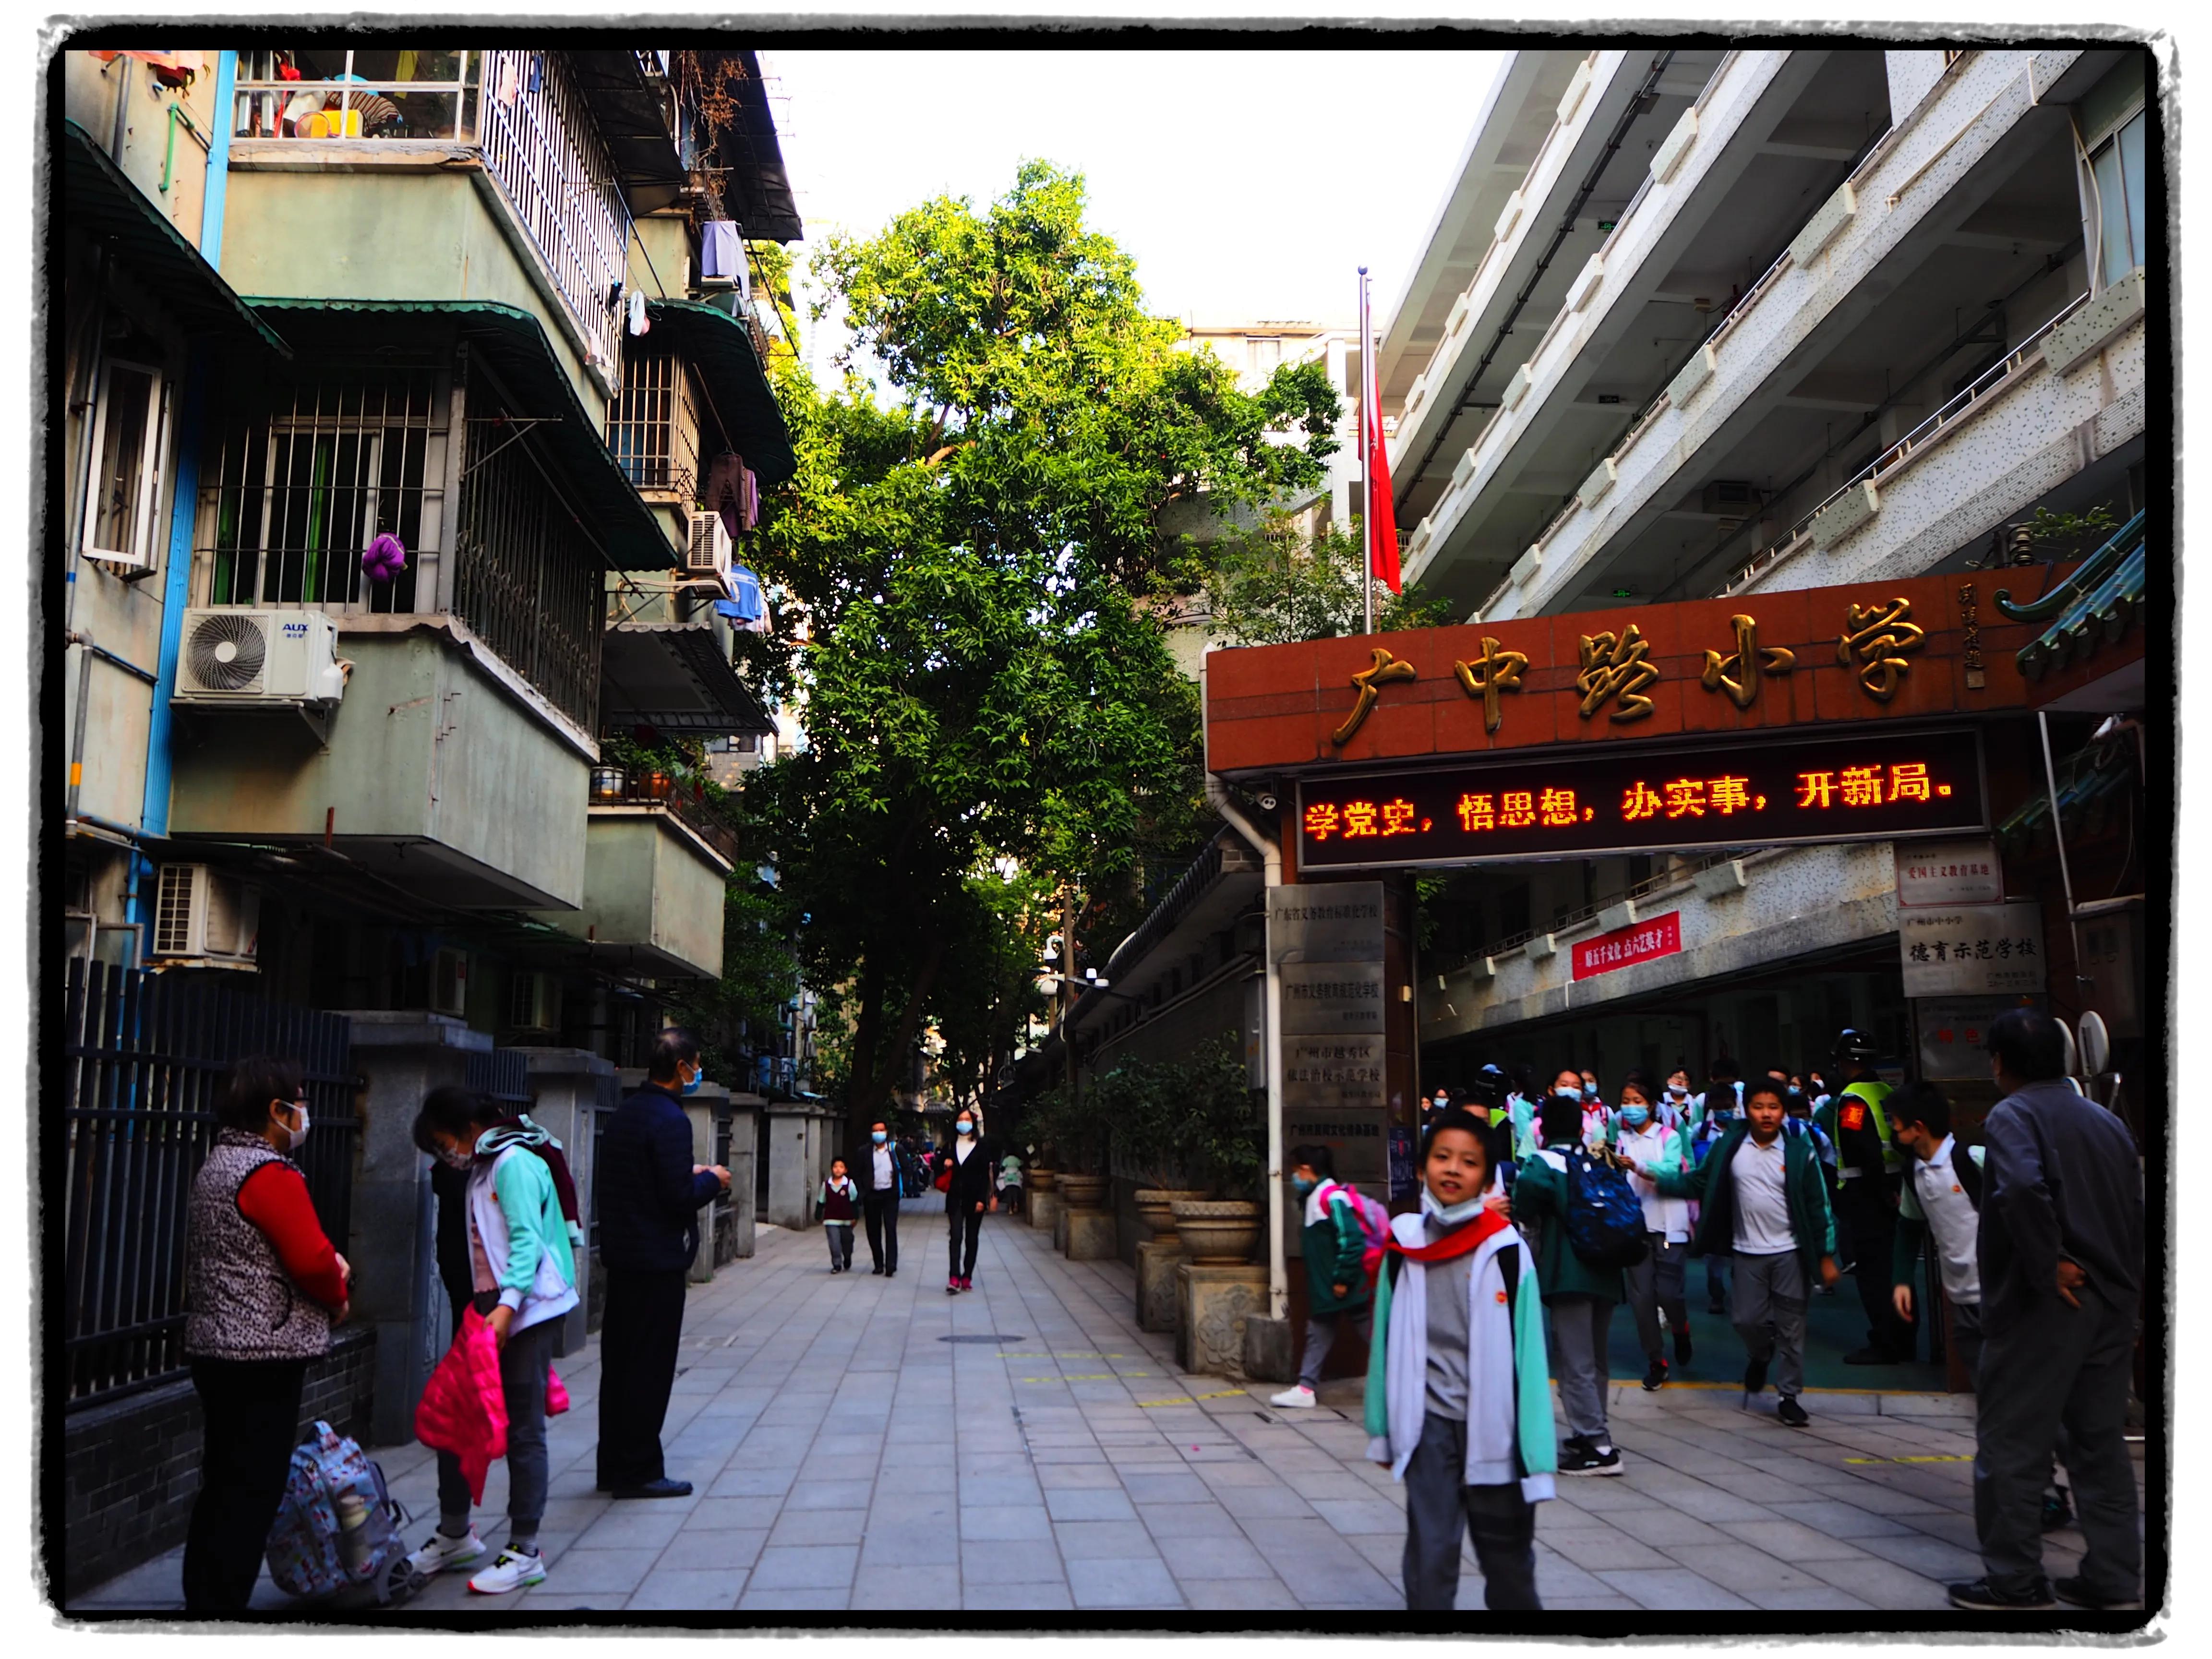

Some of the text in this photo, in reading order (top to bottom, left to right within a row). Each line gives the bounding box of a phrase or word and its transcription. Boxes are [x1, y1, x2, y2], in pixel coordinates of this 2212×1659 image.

[1333, 597, 1925, 747] 广中路小学
[1909, 864, 1990, 879] 爱国主义教育基地
[1907, 916, 1963, 926] 广州市中小学
[1910, 937, 2037, 962] 德育示范学校
[1296, 1046, 1370, 1059] 广州市越秀区
[1287, 1067, 1380, 1082] 依法治校示范学校
